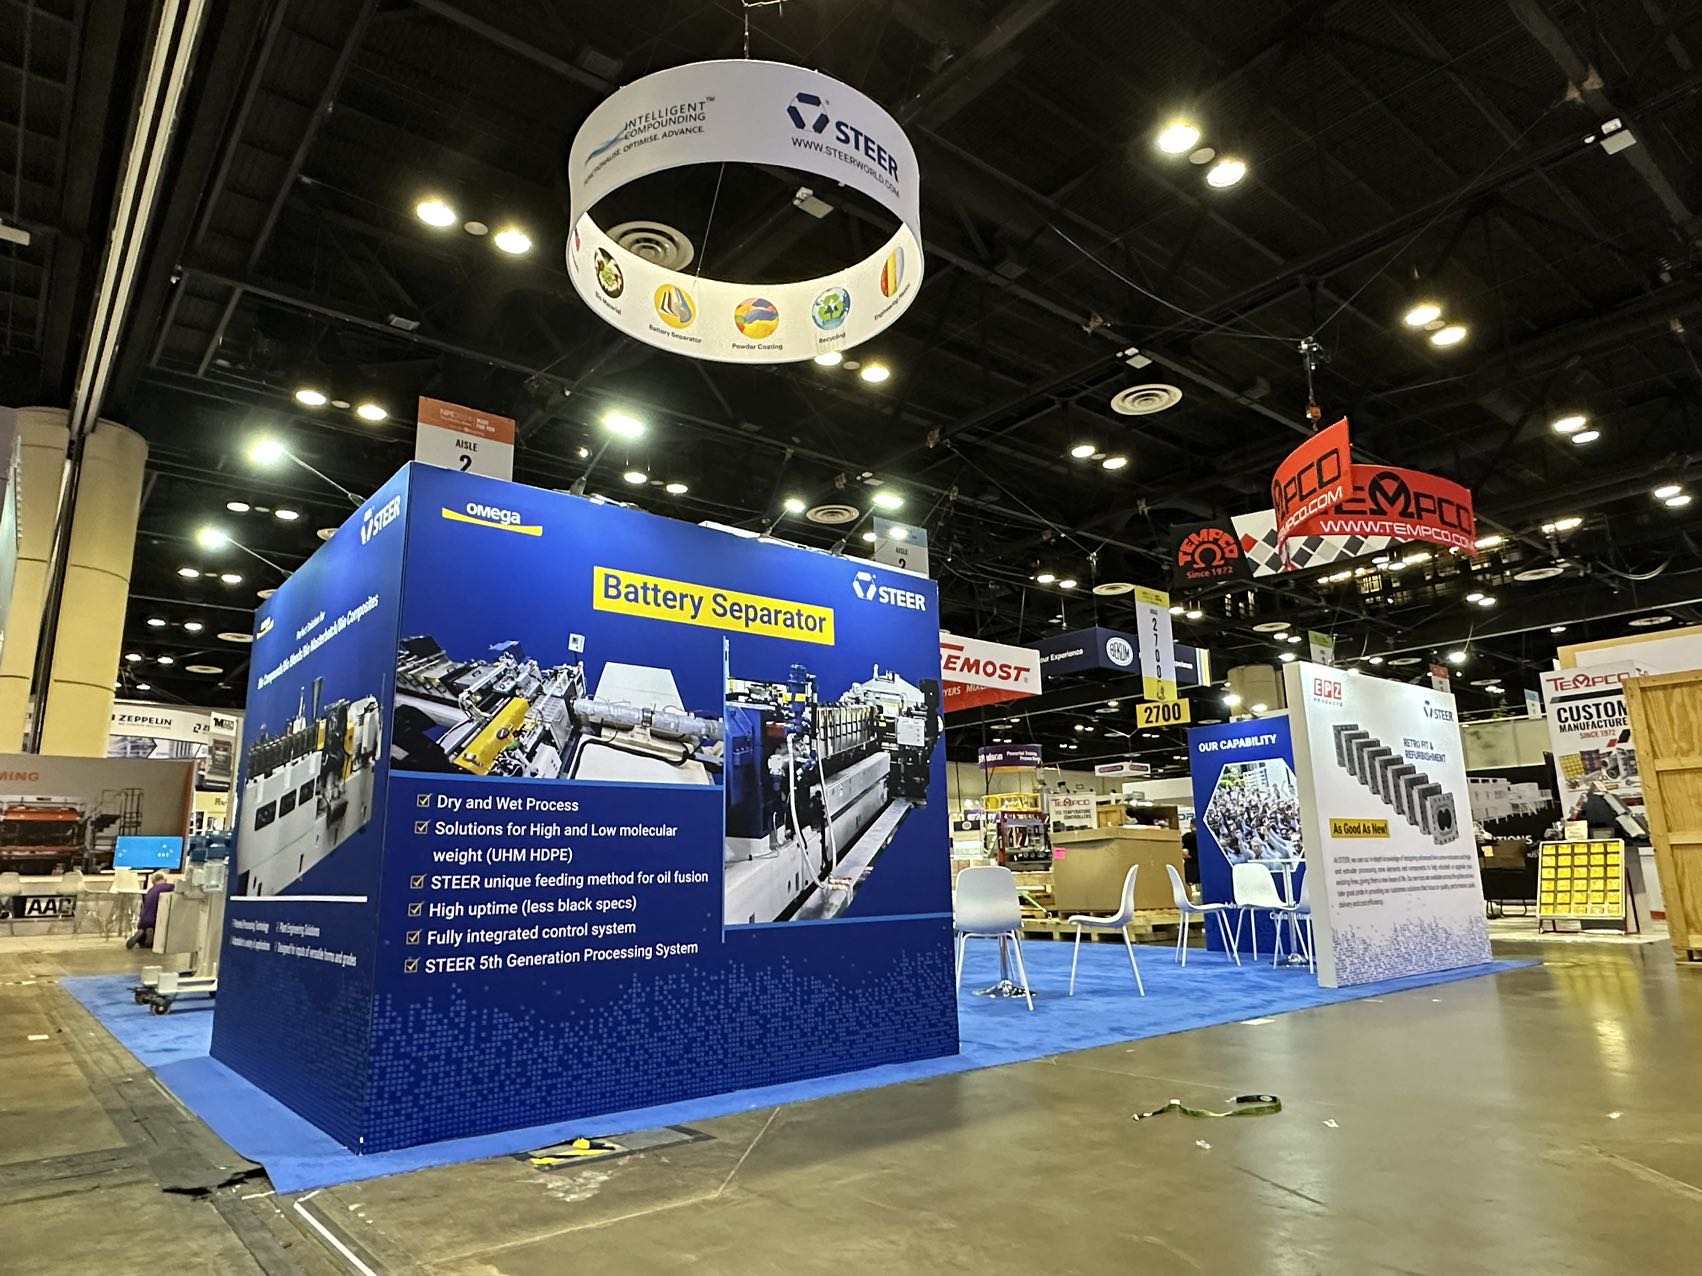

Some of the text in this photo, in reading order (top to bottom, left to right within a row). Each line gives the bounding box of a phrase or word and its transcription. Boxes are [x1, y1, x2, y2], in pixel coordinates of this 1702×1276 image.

[624, 101, 706, 130] INTELLIGENT
[624, 112, 706, 140] COMPOUNDING
[835, 120, 899, 183] STEER
[791, 137, 900, 198] WWW.STEERWORLD.COM
[757, 343, 783, 351] Coating
[818, 332, 846, 344] Recycling
[456, 439, 478, 452] AISLE
[1322, 471, 1472, 535] EMPCO
[373, 496, 401, 537] STEER
[1178, 528, 1238, 566] TEMPCO
[1186, 566, 1233, 579] Since 1972
[603, 573, 827, 633] Battery Separator
[879, 586, 926, 611] STEER
[1050, 649, 1084, 661] Experience
[1314, 678, 1341, 700] EPZ
[119, 715, 172, 726] ZEPPELIN
[1144, 702, 1181, 724] 2700
[1434, 709, 1453, 721] STEER
[1199, 734, 1277, 752] OUR CAPABILITY
[1580, 729, 1616, 739] SINCE 1972
[437, 794, 579, 812] Dry and Wet Process
[435, 821, 678, 839] Solutions for High and Low molecular
[1333, 822, 1342, 834] As
[1344, 822, 1361, 834] Good
[1363, 823, 1371, 834] As
[433, 847, 573, 865] weight (UHM HDPE)
[431, 870, 709, 890] STEER unique feeding method for oil fusion
[429, 895, 637, 919] High uptime (less black specs)
[427, 922, 636, 947] Fully integrated control system
[425, 943, 698, 973] STEER 5th Generation Processing System
